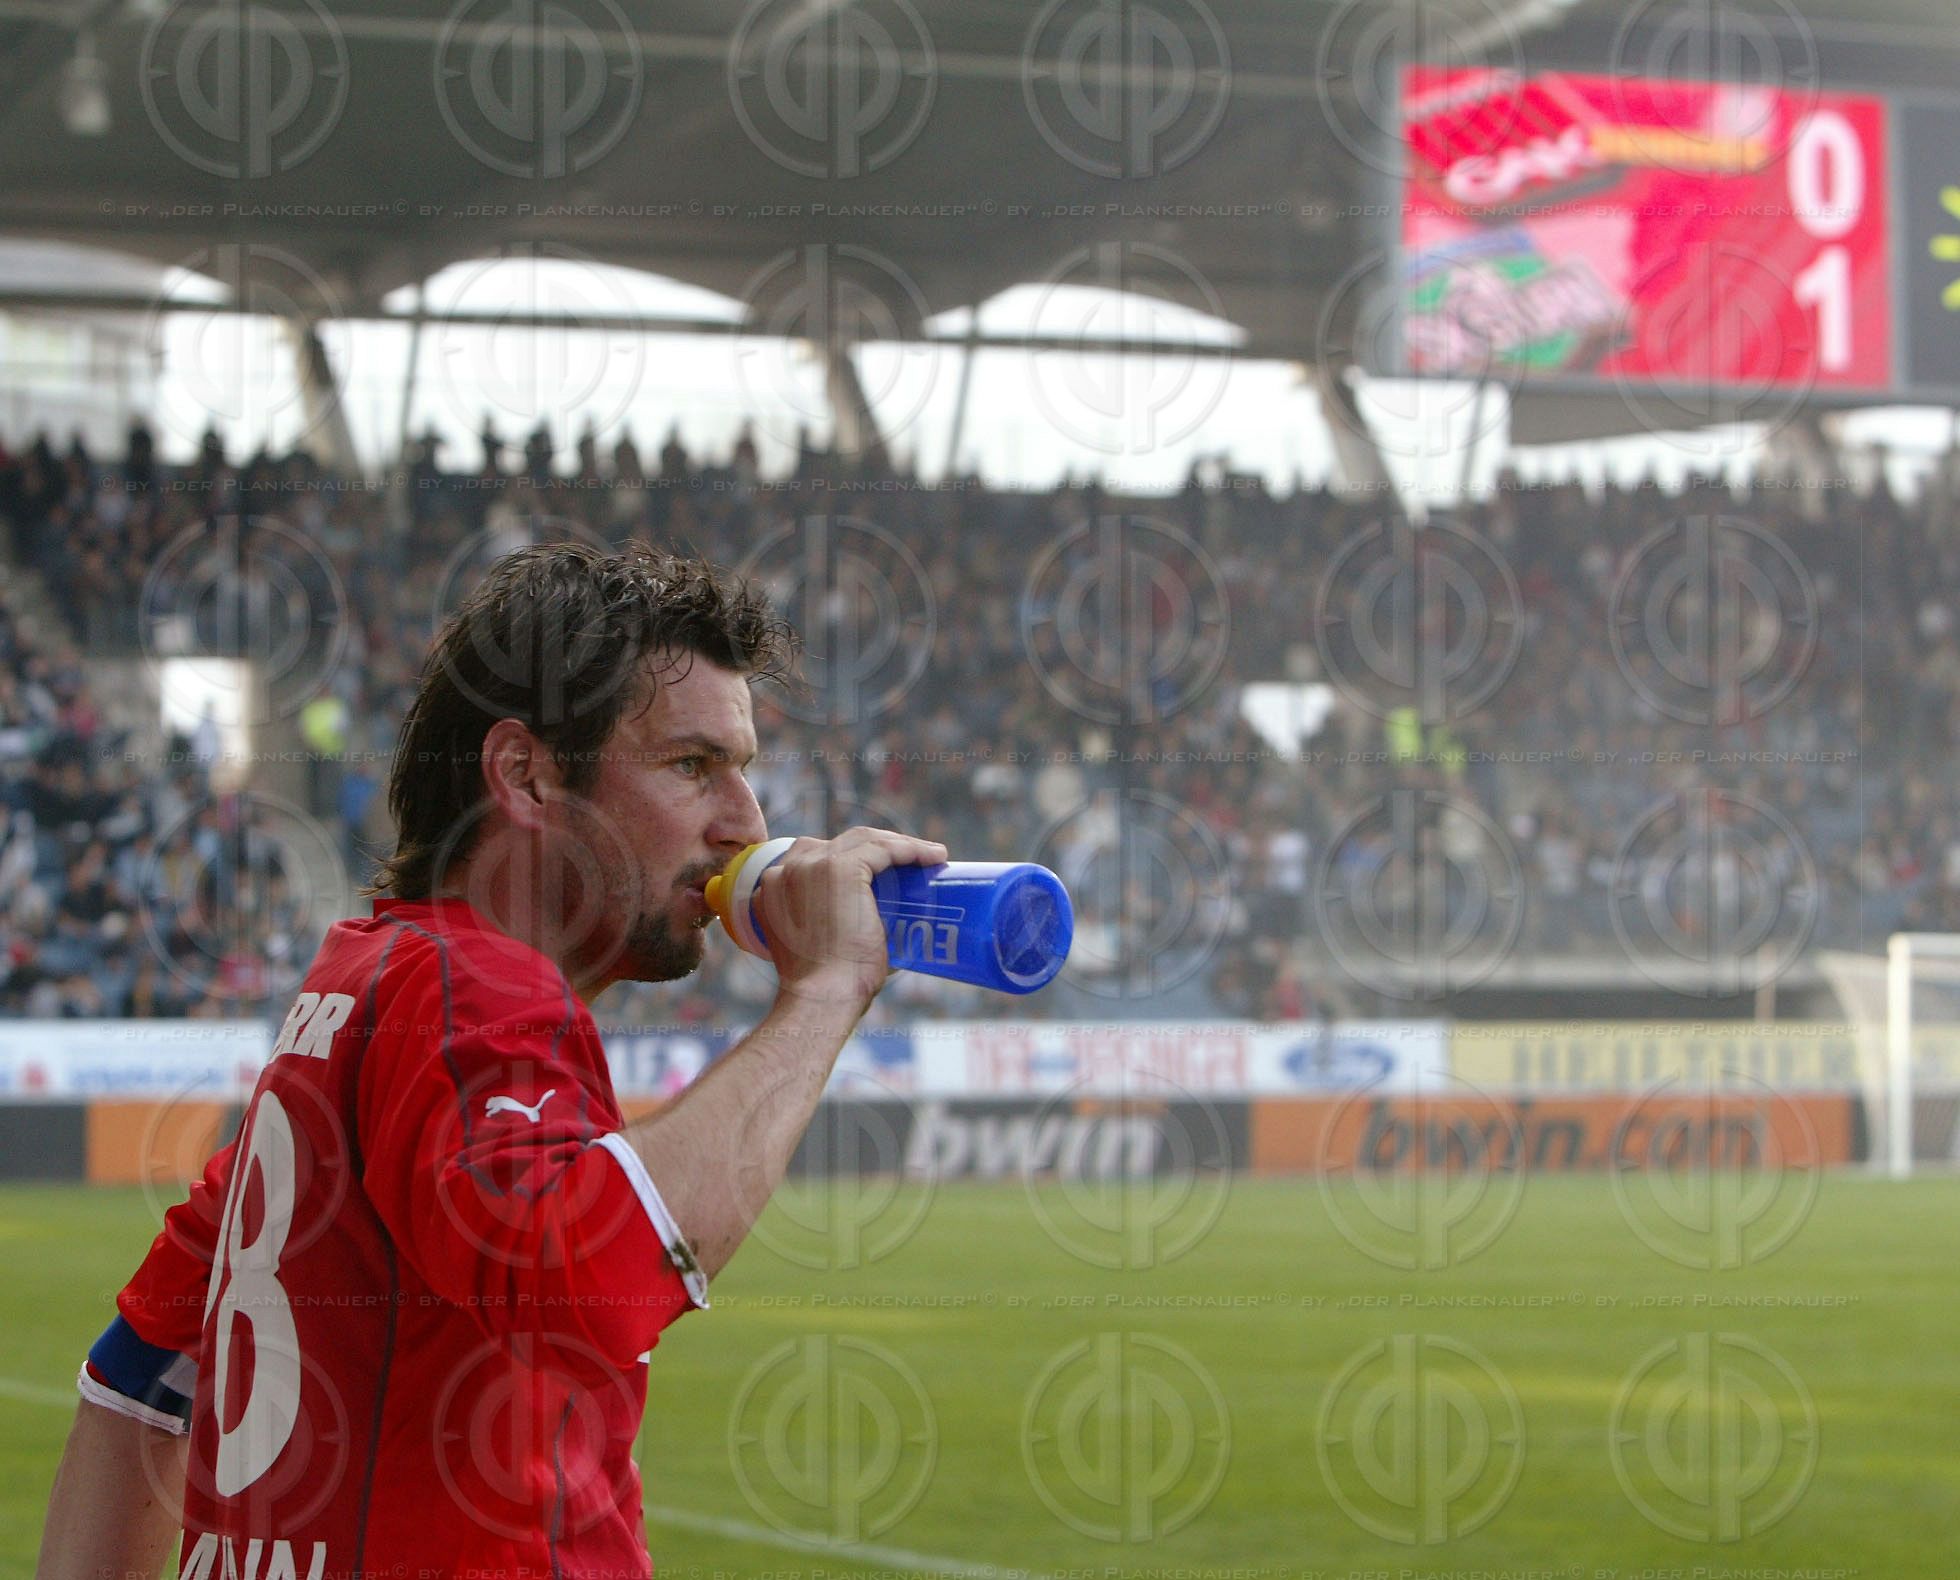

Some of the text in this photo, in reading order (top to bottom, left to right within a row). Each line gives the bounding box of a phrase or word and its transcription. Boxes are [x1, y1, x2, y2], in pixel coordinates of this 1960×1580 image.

[1788, 110, 1864, 239] 0
[1795, 245, 1852, 372] 1
[901, 1099, 1160, 1178] bwin
